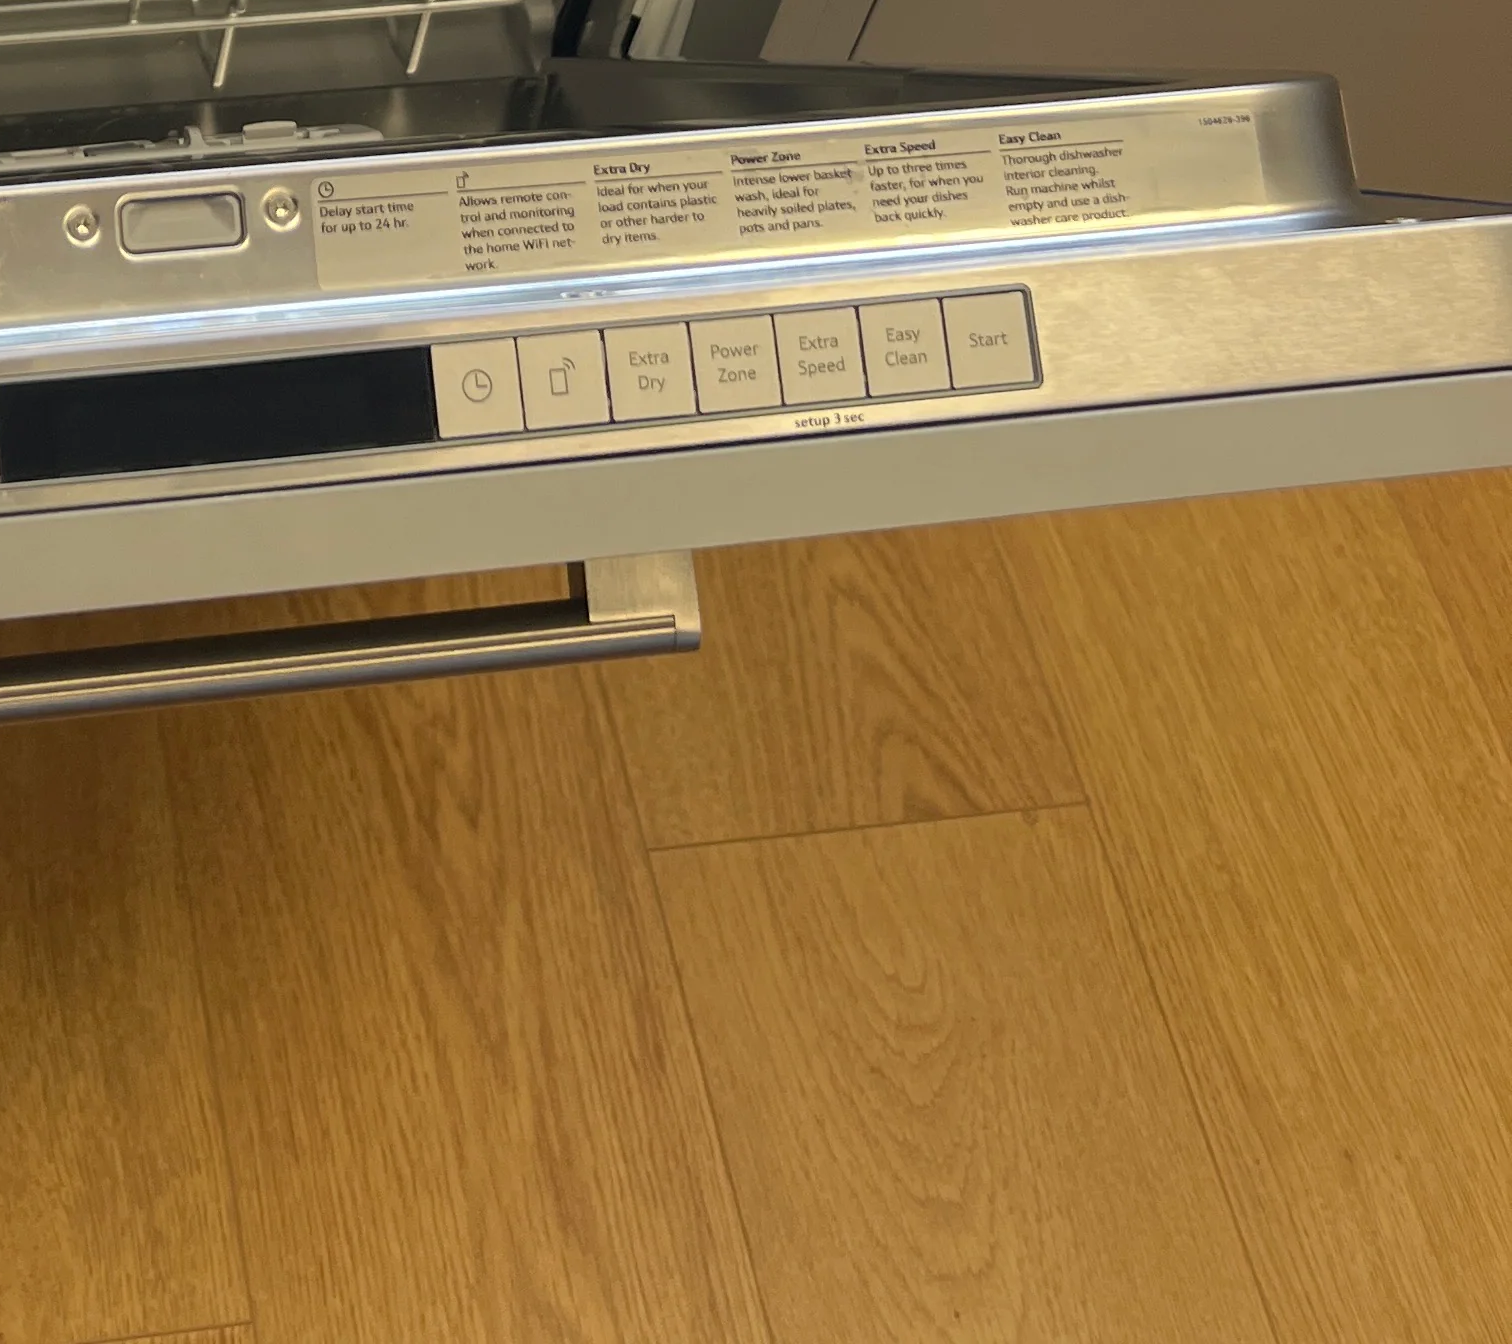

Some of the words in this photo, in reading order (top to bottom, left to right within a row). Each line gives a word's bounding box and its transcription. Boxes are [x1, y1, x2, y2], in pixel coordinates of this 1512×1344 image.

[998, 133, 1025, 146] Easy
[1028, 130, 1062, 143] Clean
[864, 143, 897, 155] Extra
[899, 139, 936, 153] Speed
[731, 152, 768, 165] Power
[771, 150, 802, 162] Zone
[1002, 151, 1057, 166] Thorough
[1059, 147, 1123, 162] dishwasher
[593, 163, 627, 176] Extra
[629, 161, 651, 175] Dry
[733, 173, 776, 187] Intense
[778, 171, 811, 183] lower
[814, 167, 853, 181] basket
[868, 165, 884, 178] Up
[886, 164, 899, 175] to
[902, 161, 933, 173] three
[936, 159, 967, 172] times
[1004, 168, 1046, 181] interior
[1048, 164, 1100, 180] cleaning.
[597, 184, 626, 197] Ideal
[627, 182, 644, 195] for
[647, 180, 680, 193] when
[682, 180, 709, 192] your
[870, 178, 906, 193] faster,
[909, 177, 925, 189] for
[928, 175, 960, 187] when
[963, 174, 984, 187] you
[1005, 185, 1028, 197] Run
[1031, 181, 1079, 195] machine
[1082, 178, 1116, 191] whilst
[458, 195, 498, 208] Allows
[500, 192, 543, 205] remote
[546, 191, 572, 202] con-
[735, 190, 770, 203] wash,
[772, 187, 800, 199] ideal
[802, 185, 820, 197] for
[872, 195, 901, 208] need
[903, 193, 928, 206] your
[931, 189, 968, 204] dishes
[319, 205, 352, 219] Delay
[355, 203, 384, 216] start
[388, 201, 414, 213] time
[598, 200, 624, 213] load
[627, 197, 677, 211] contains
[679, 194, 717, 208] plastic
[736, 204, 778, 220] heavily
[780, 201, 815, 214] soiled
[817, 198, 856, 213] plates,
[1008, 200, 1044, 214] empty
[1046, 197, 1068, 209] and
[1070, 196, 1091, 207] use
[1102, 192, 1130, 204] dish-
[460, 211, 482, 224] trol
[484, 209, 506, 221] and
[509, 205, 575, 220] monitoring
[600, 219, 613, 229] or
[615, 214, 647, 228] other
[650, 212, 689, 225] harder
[691, 211, 705, 222] to
[874, 210, 902, 224] back
[1009, 214, 1052, 227] washer
[1055, 213, 1079, 223] care
[1082, 208, 1130, 224] product.
[321, 221, 338, 234] for
[341, 222, 356, 234] up
[359, 220, 372, 231] to
[375, 218, 390, 230] 24
[461, 227, 495, 239] when
[497, 222, 560, 236] connected
[562, 221, 575, 232] to
[739, 223, 765, 236] pots
[767, 219, 790, 232] and
[792, 218, 824, 231] pans.
[463, 243, 484, 255] the
[486, 240, 520, 254] home
[552, 237, 577, 249] net-
[602, 232, 621, 246] dry
[465, 258, 498, 271] work.
[798, 335, 838, 351] Extra
[885, 327, 920, 344] Easy
[969, 331, 1008, 348] Start
[628, 351, 670, 367] Extra
[710, 343, 759, 360] Power
[885, 350, 928, 366] Clean
[717, 367, 757, 383] Zone
[798, 357, 846, 377] Speed
[638, 375, 665, 393] Dry
[794, 414, 830, 428] setup
[834, 412, 841, 424] 3
[844, 412, 865, 423] sec
